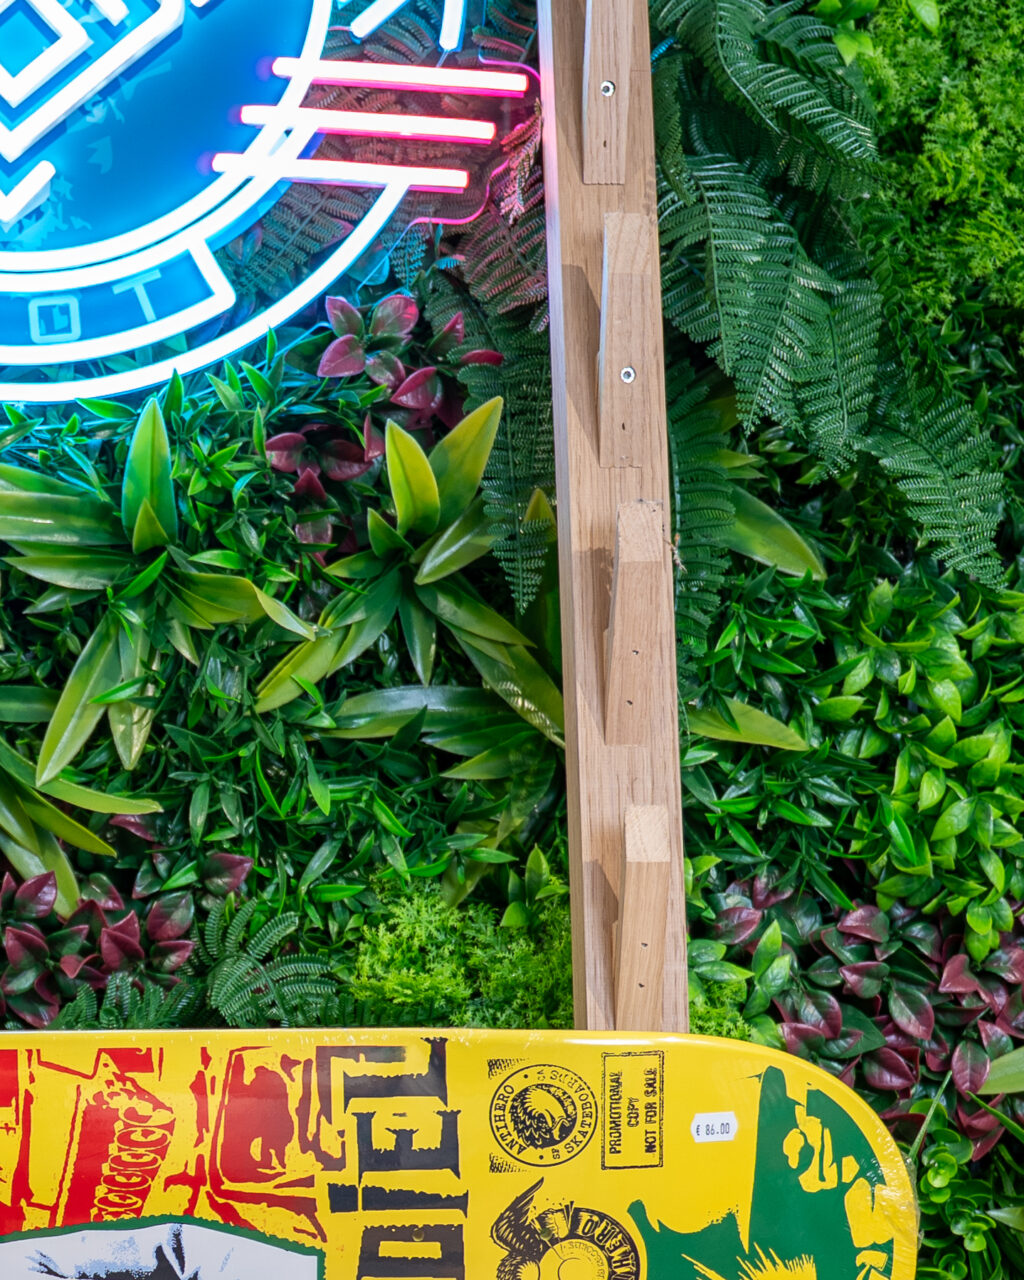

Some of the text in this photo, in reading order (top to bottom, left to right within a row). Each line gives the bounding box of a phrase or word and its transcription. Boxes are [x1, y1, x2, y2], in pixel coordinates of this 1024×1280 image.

[494, 1084, 527, 1155] ANTIHERO
[550, 1069, 593, 1154] SKATEBOARDS
[608, 1071, 623, 1155] PROMOTIONAL
[627, 1097, 639, 1128] COPY
[644, 1067, 658, 1154] NOT FOR SALE
[705, 1122, 730, 1136] 86.00
